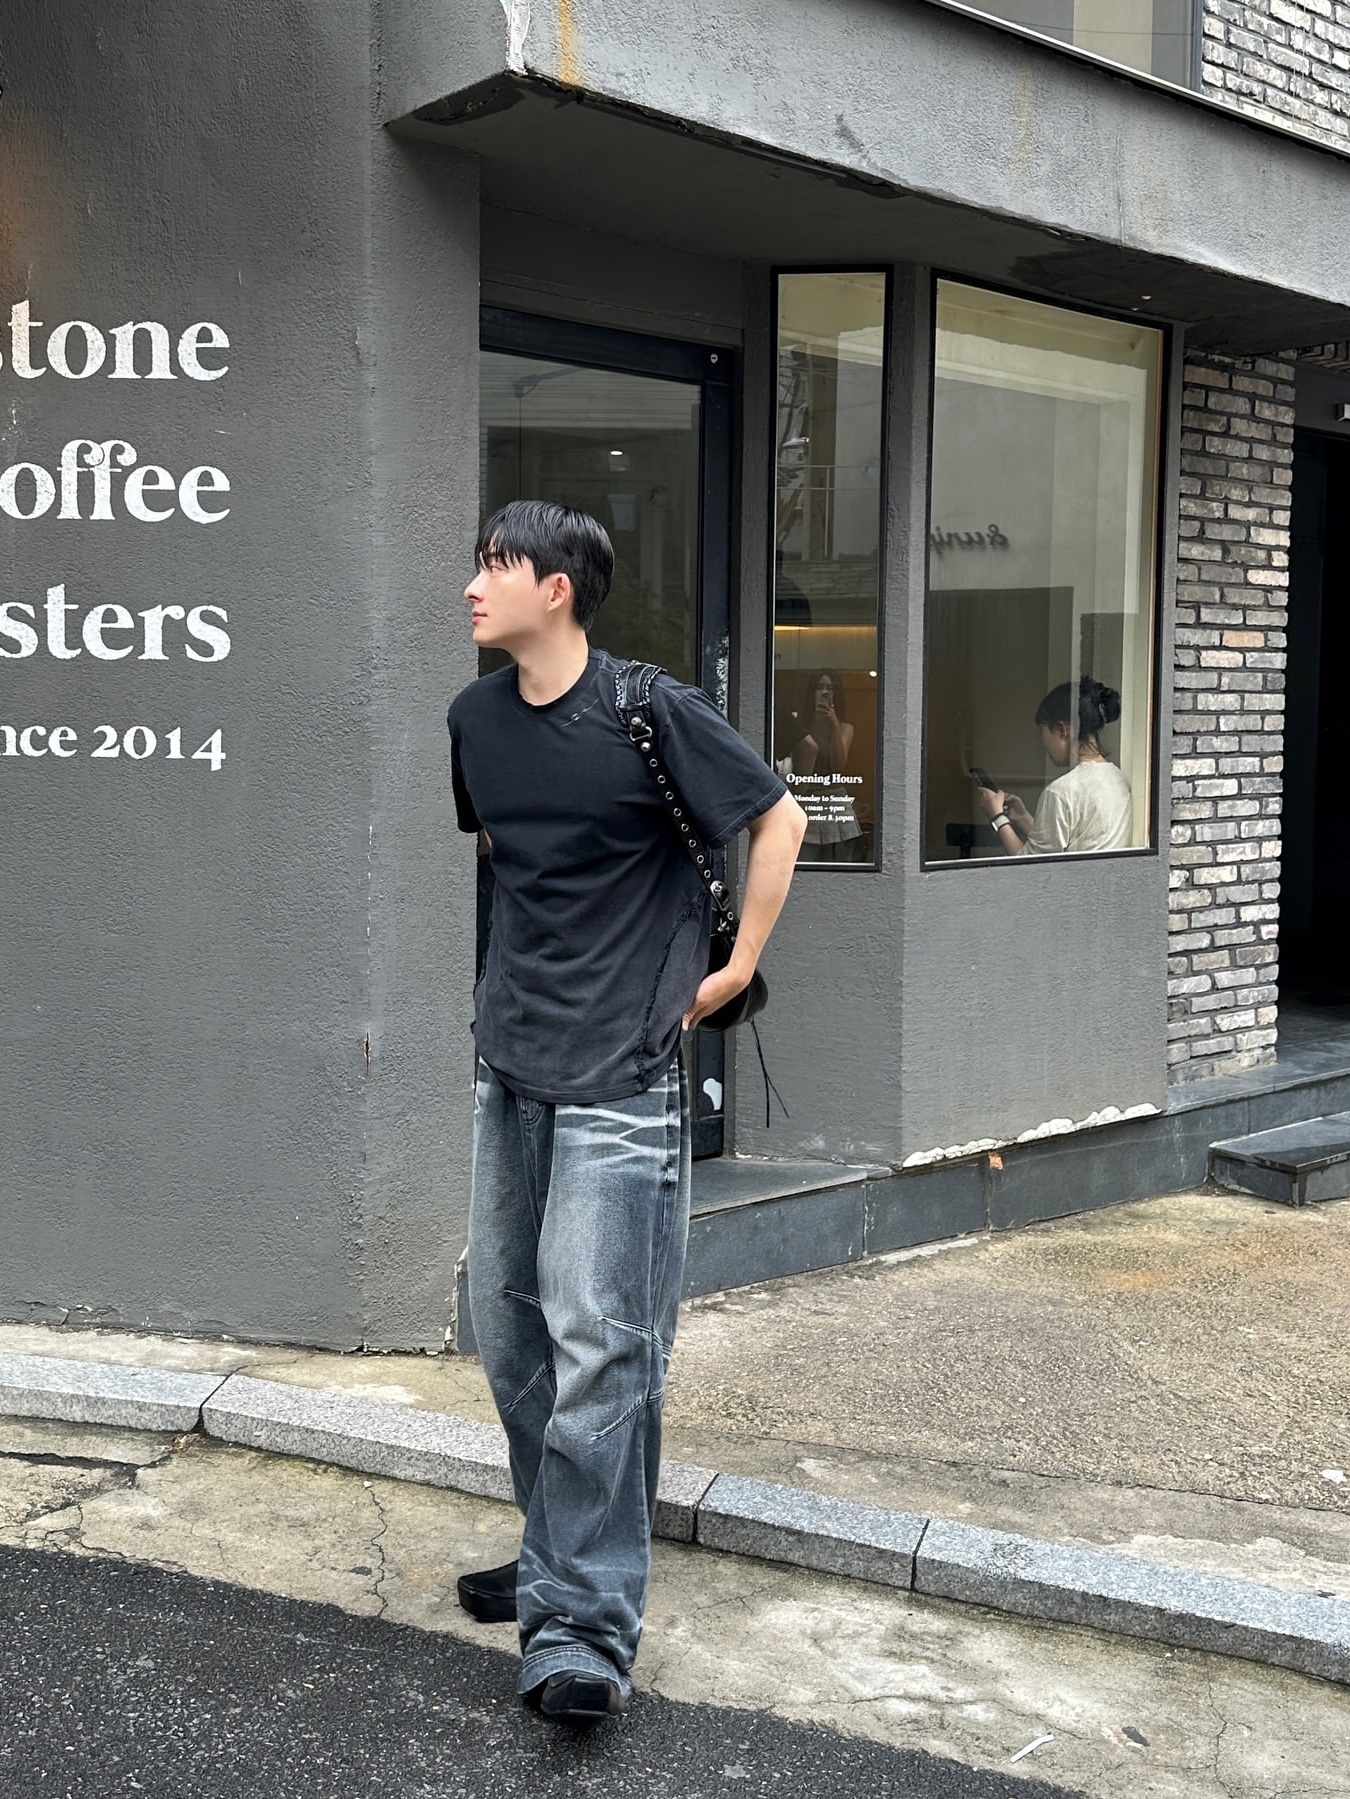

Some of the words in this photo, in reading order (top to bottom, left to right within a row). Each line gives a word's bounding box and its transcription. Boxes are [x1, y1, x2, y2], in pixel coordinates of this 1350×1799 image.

[0, 299, 231, 381] tone
[0, 439, 231, 524] offee
[0, 583, 232, 662] sters
[91, 725, 227, 772] 2014
[786, 773, 831, 786] Opening
[832, 773, 863, 784] Hours
[794, 794, 821, 804] Monday
[829, 794, 856, 804] Sunday
[829, 805, 845, 813] 9pm
[808, 813, 827, 821] order
